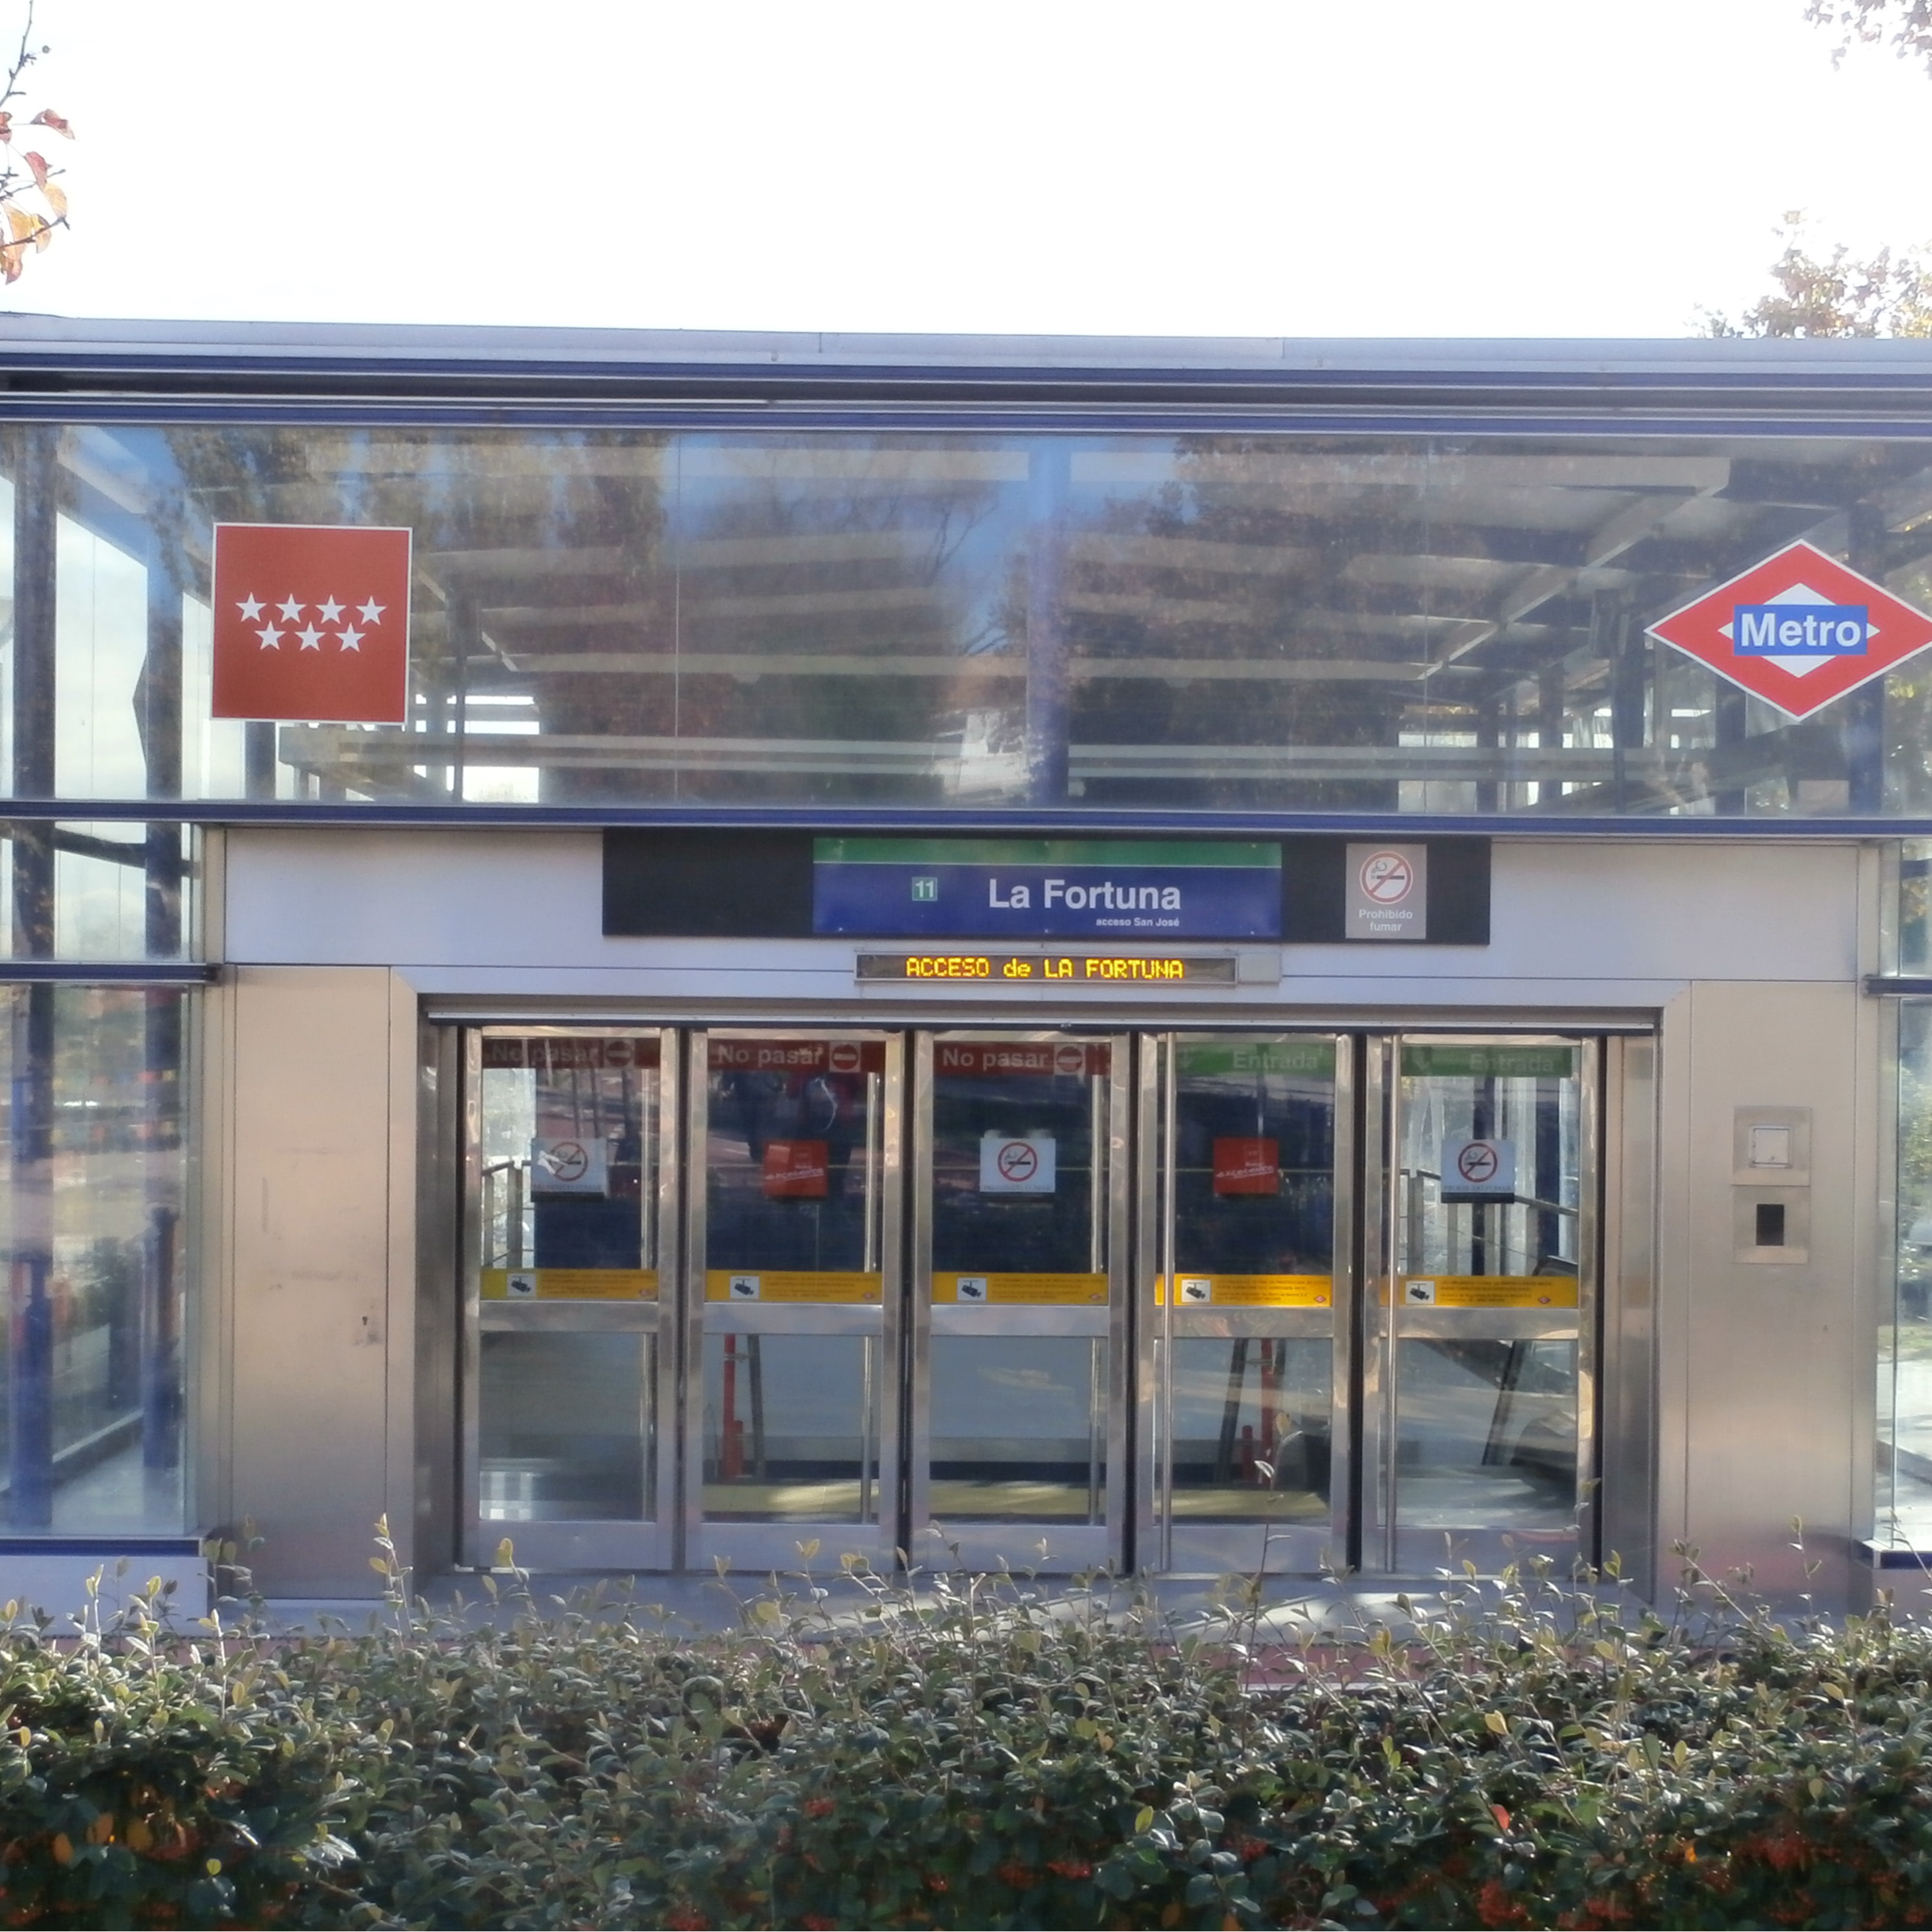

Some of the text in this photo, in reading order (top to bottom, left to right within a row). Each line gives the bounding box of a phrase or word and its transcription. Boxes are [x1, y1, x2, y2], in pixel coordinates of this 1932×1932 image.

[1741, 613, 1861, 647] Metro
[915, 880, 935, 898] 11
[990, 878, 1181, 911] La Fortuna
[1133, 917, 1154, 927] San
[1156, 917, 1180, 927] José
[1359, 909, 1413, 919] Prohibido
[1369, 921, 1402, 932] fumar
[906, 957, 1184, 979] ACCESO de LA FORTUNA
[718, 1046, 824, 1068] No pasar
[942, 1049, 1047, 1070] No pasar
[1233, 1051, 1318, 1069] Entrada
[1469, 1054, 1554, 1072] Entrada
